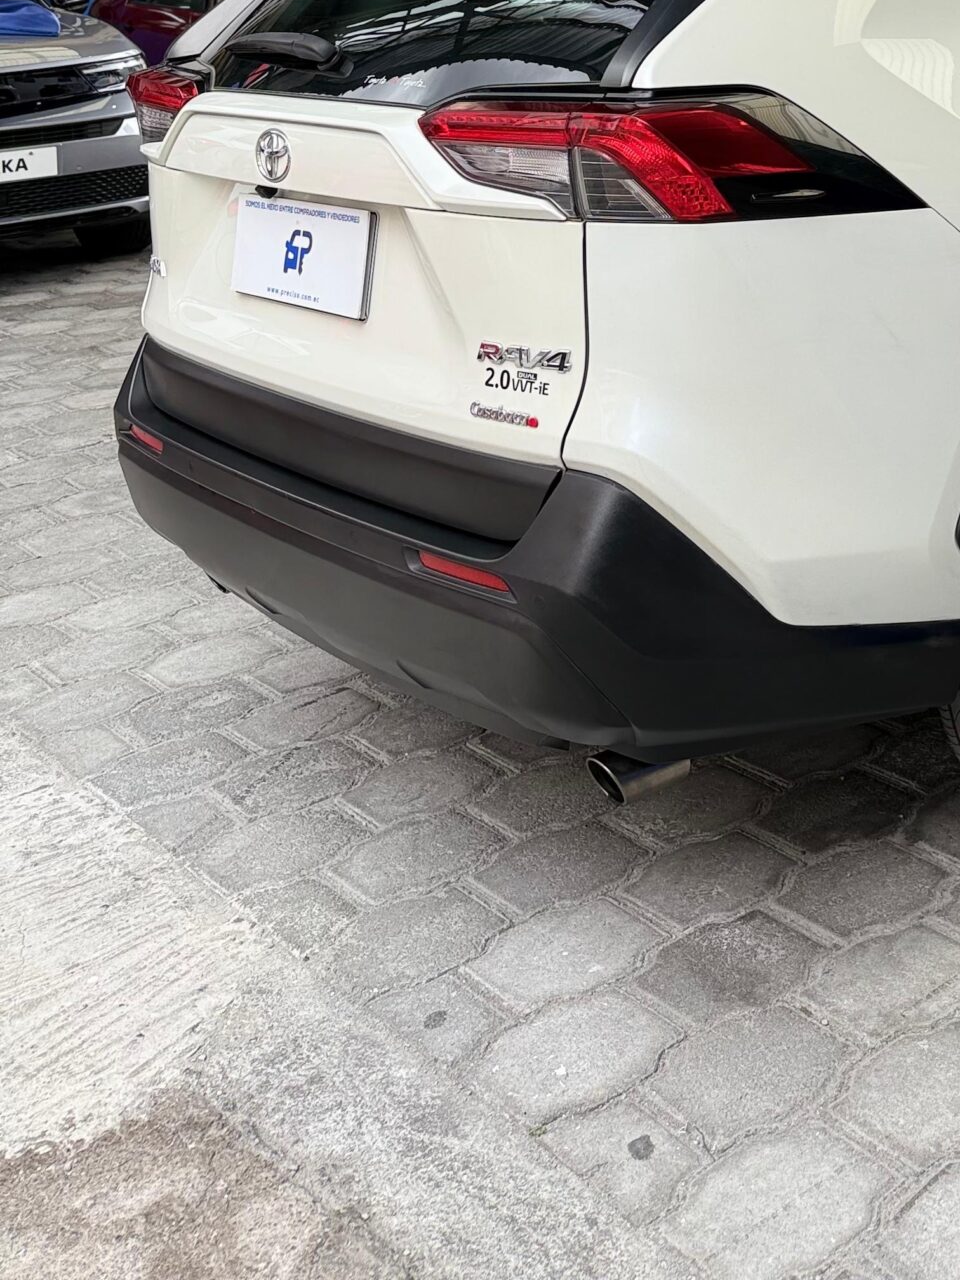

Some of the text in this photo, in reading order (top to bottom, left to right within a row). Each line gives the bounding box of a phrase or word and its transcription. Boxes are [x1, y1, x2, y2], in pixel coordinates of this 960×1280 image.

[1, 157, 29, 174] KA
[245, 199, 260, 209] SOMOS
[261, 202, 267, 210] EL
[279, 204, 294, 214] ENTRE
[294, 206, 327, 219] COMPRADORES
[331, 212, 361, 224] VENDEDORES
[477, 340, 573, 374] RAV4
[484, 366, 551, 396] 2.0 VVT-iE
[518, 370, 537, 381] DUAL
